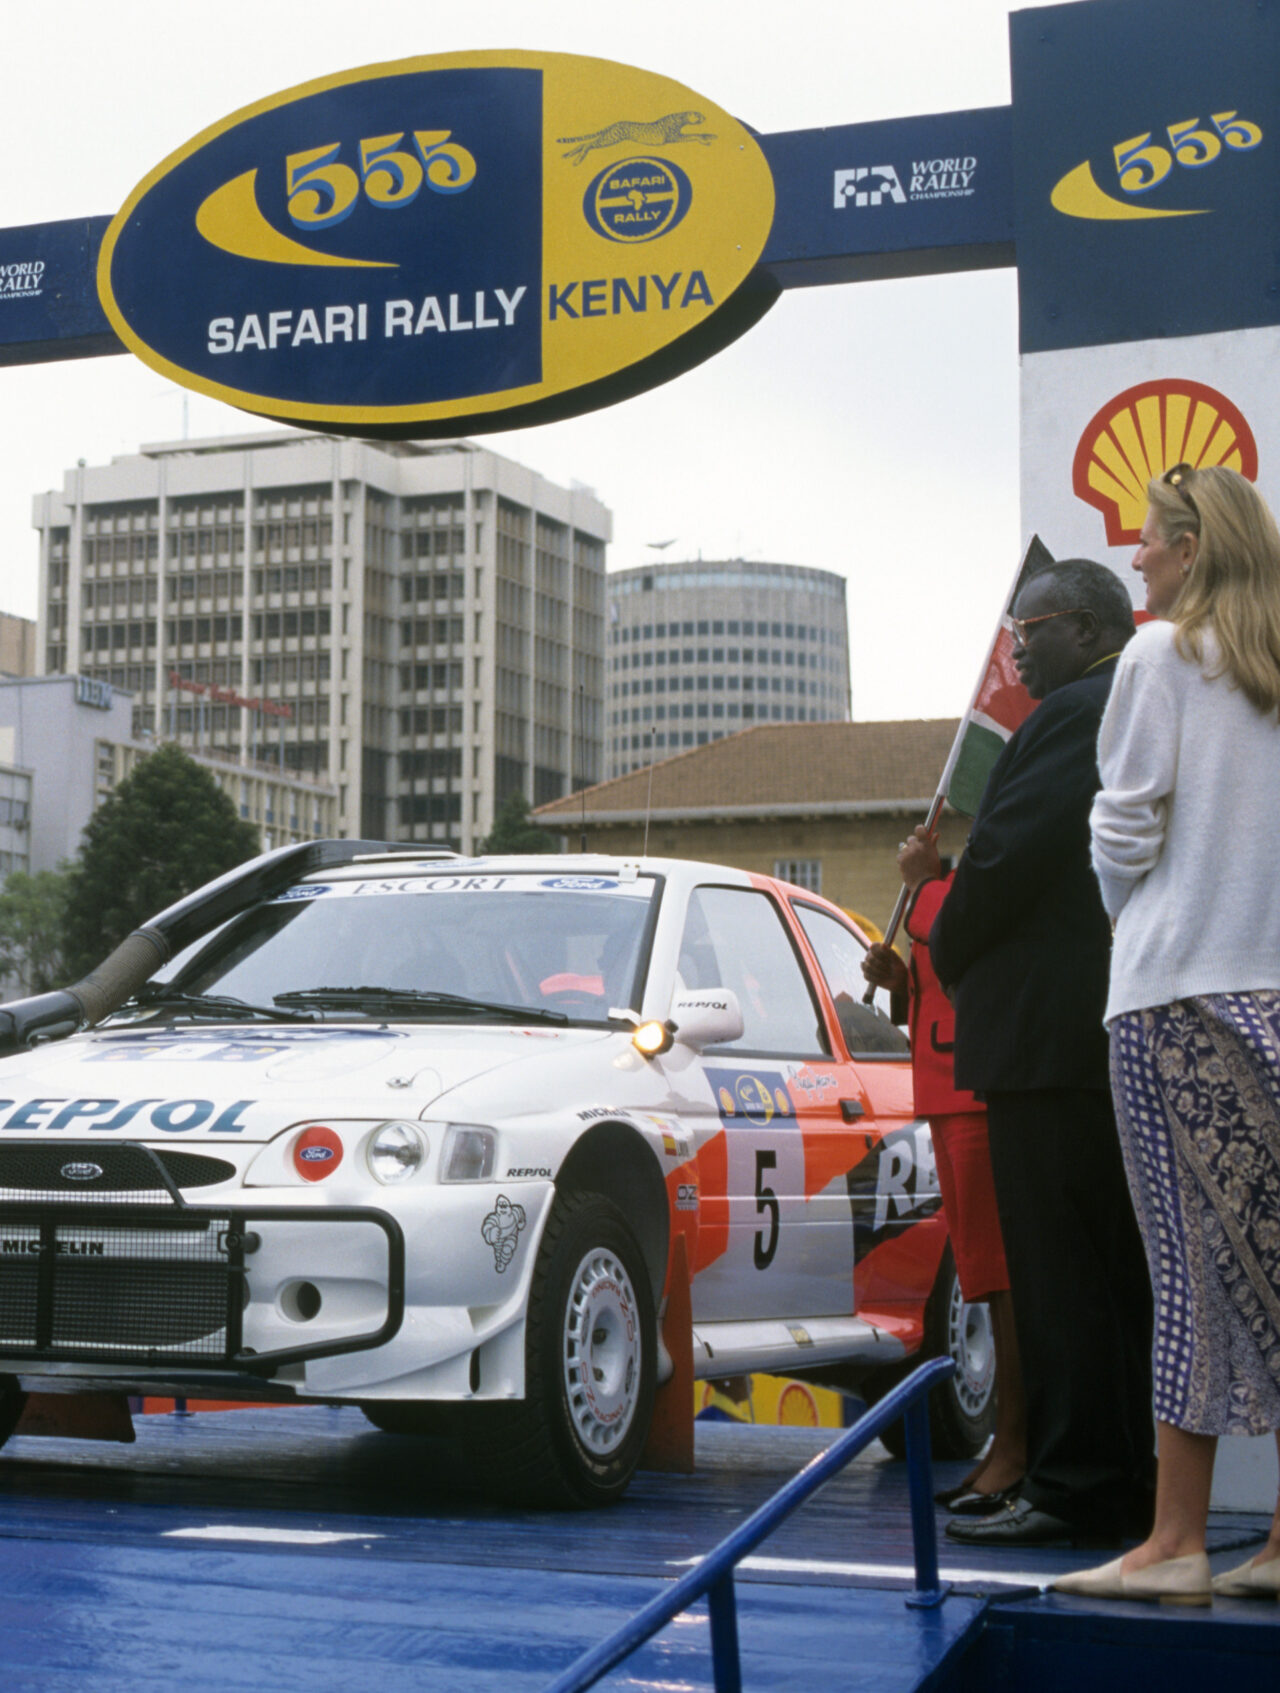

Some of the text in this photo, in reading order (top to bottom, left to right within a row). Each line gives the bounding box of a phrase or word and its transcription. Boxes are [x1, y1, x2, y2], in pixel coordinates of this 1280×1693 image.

[1112, 110, 1263, 196] 555
[911, 157, 977, 175] WORLD
[286, 130, 477, 231] 555
[609, 174, 666, 190] SAFARI
[833, 165, 908, 208] FIA
[909, 171, 975, 193] RALLY
[910, 188, 975, 200] CHAMPIONSHIP
[613, 210, 661, 225] RALLY
[548, 270, 715, 320] KENYA
[208, 286, 527, 354] SAFARI RALLY
[352, 876, 517, 896] ESCORT
[552, 876, 610, 890] Ford
[677, 999, 728, 1011] REPSOL
[506, 1167, 552, 1177] REPSOL
[753, 1149, 781, 1271] 5
[2, 1240, 104, 1255] MICELIN
